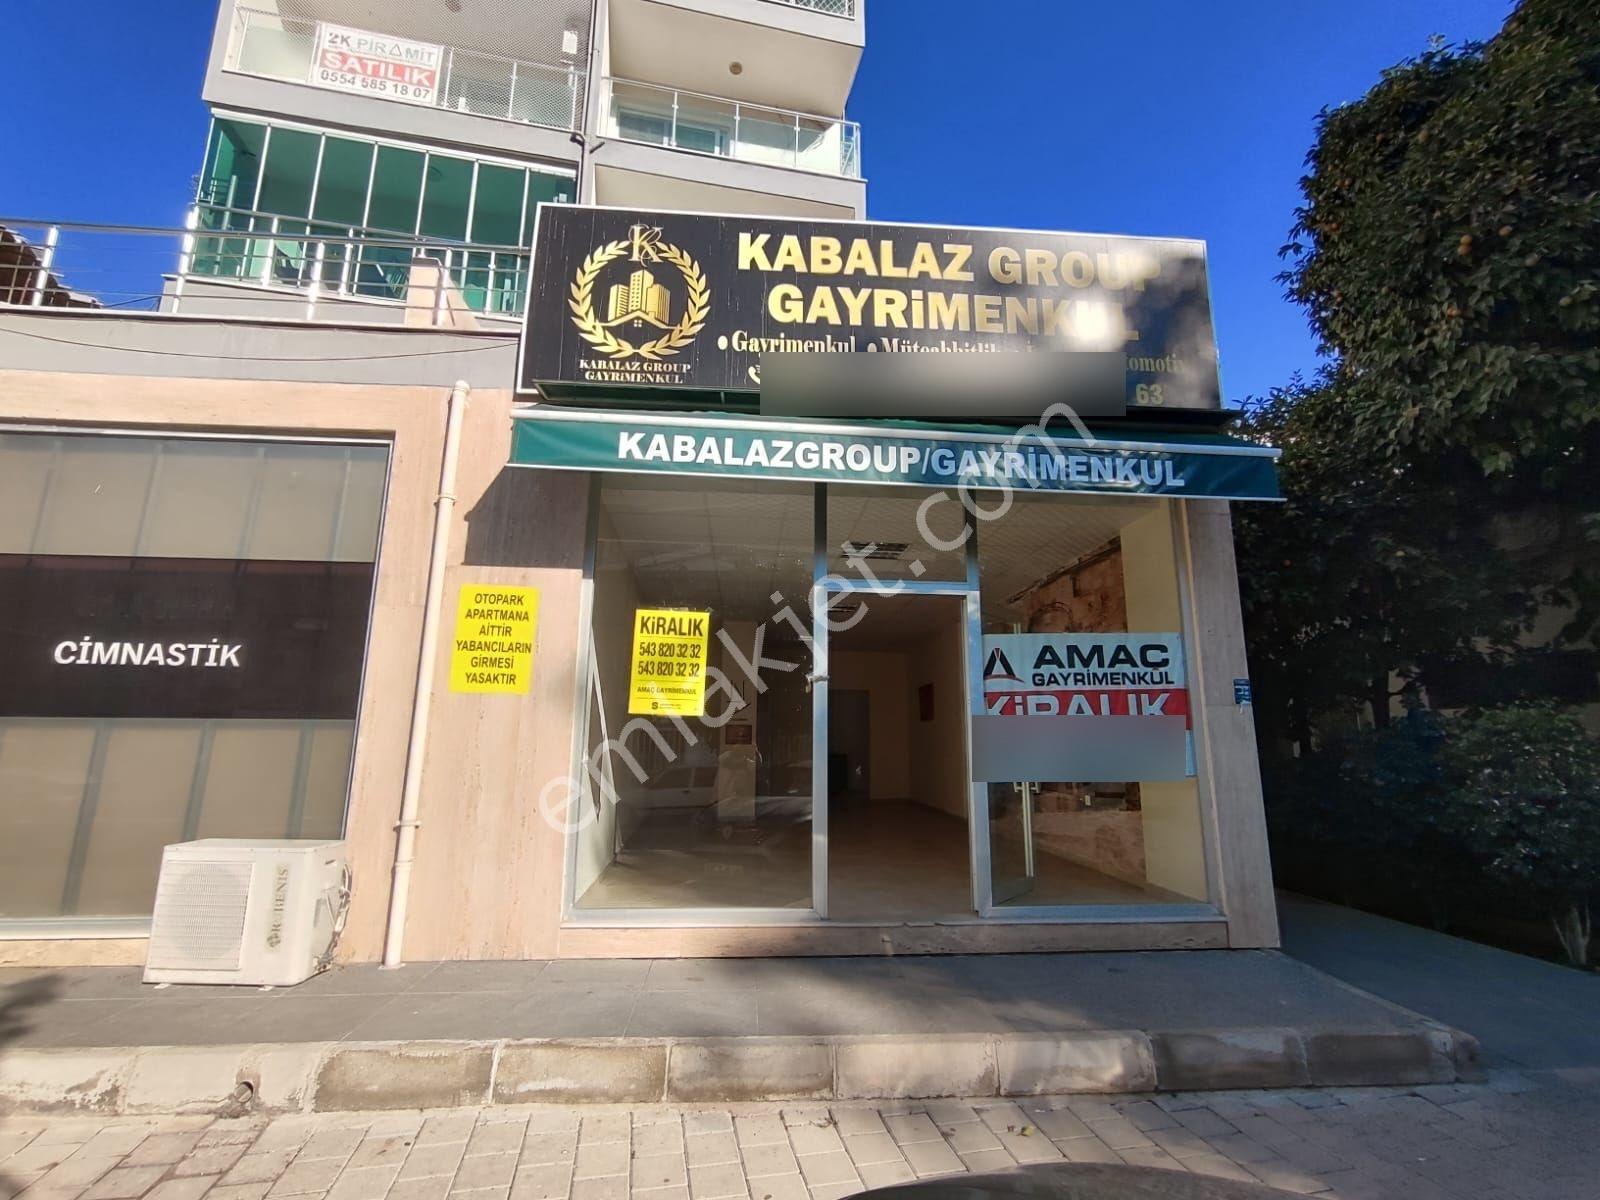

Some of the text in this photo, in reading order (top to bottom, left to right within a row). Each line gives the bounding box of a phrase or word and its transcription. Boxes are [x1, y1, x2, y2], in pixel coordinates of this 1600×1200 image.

[328, 32, 351, 47] 2K
[322, 51, 433, 87] SATILIK
[321, 69, 431, 99] 0554 585 18 07
[738, 232, 975, 282] KABALAZ
[579, 359, 691, 374] KABALAZ GROUP
[1135, 383, 1165, 405] 63
[474, 593, 525, 606] OTOPARK
[465, 608, 529, 622] APARTMANA
[479, 622, 513, 637] AİTTİR
[54, 636, 242, 667] CİMNASTİK
[456, 640, 532, 654] YABANCILARIN
[640, 642, 702, 658] 543 820 32 32
[471, 654, 514, 669] GİRMESİ
[638, 661, 700, 677] 543 820 32 32
[465, 672, 516, 685] YASAKTIR
[1032, 669, 1175, 687] GAYRİMENKUL
